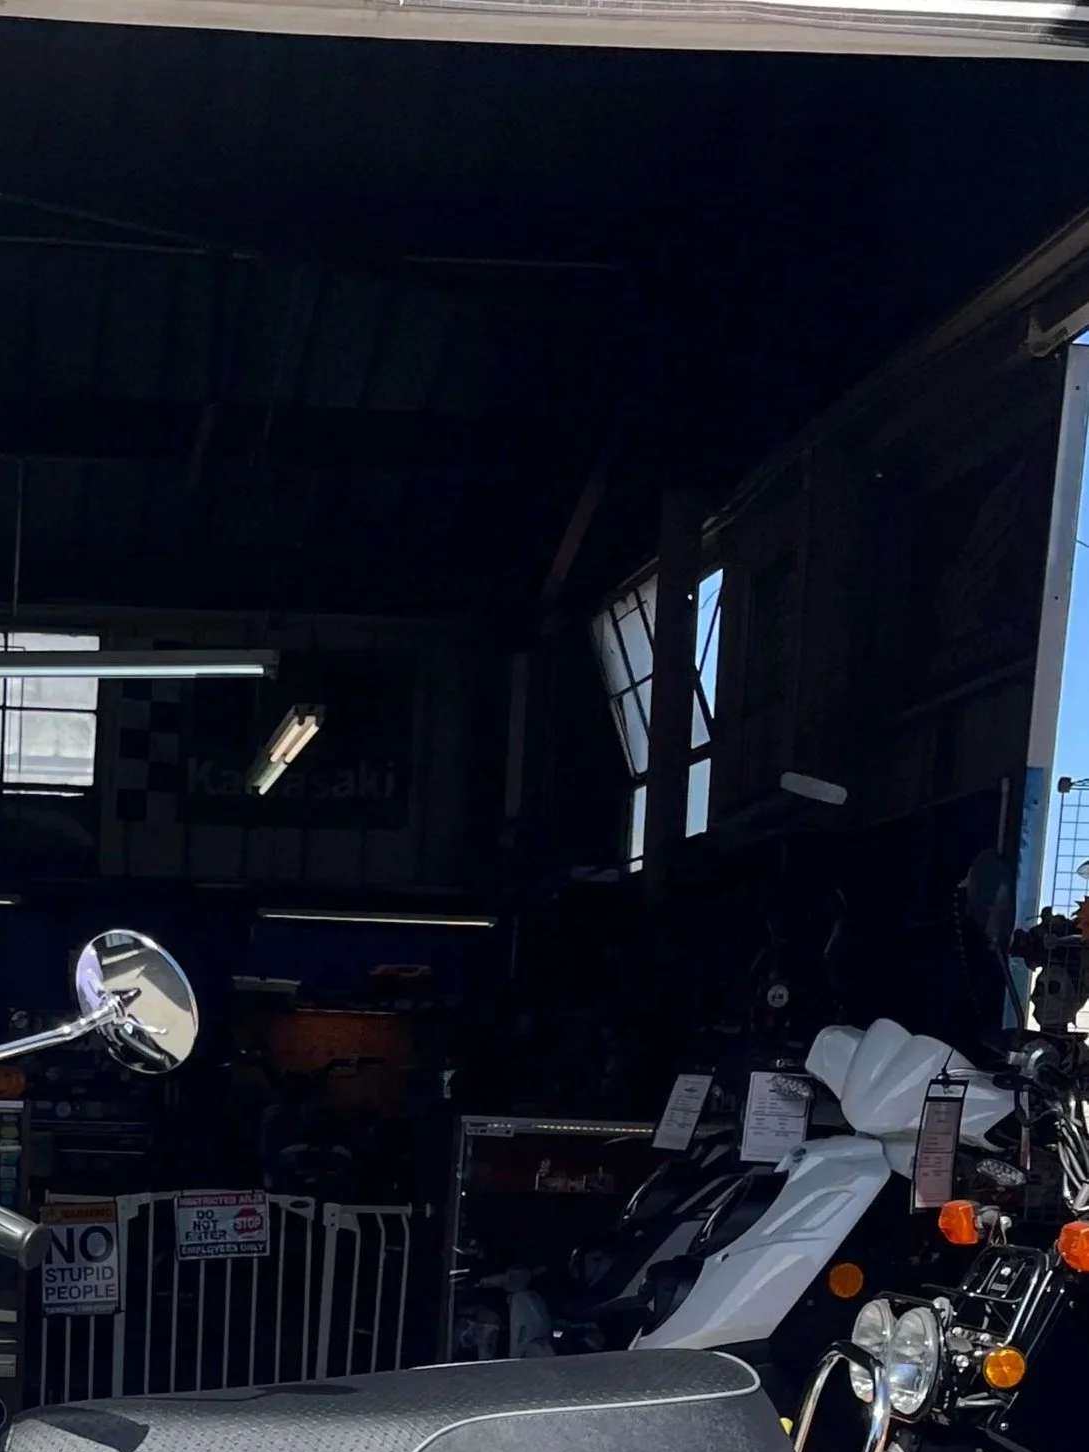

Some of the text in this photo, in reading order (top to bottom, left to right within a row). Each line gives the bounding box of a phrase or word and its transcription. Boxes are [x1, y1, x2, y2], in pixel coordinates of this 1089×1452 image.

[187, 756, 396, 798] Kaasaki
[196, 1209, 215, 1220] DO
[192, 1219, 219, 1231] NOT
[234, 1216, 262, 1230] STOP
[185, 1230, 227, 1241] ENTER
[44, 1225, 115, 1264] NO
[181, 1242, 264, 1255] EMPLOYEES ONLY
[44, 1265, 115, 1283] STUPID
[44, 1283, 117, 1301] PEOPLE
